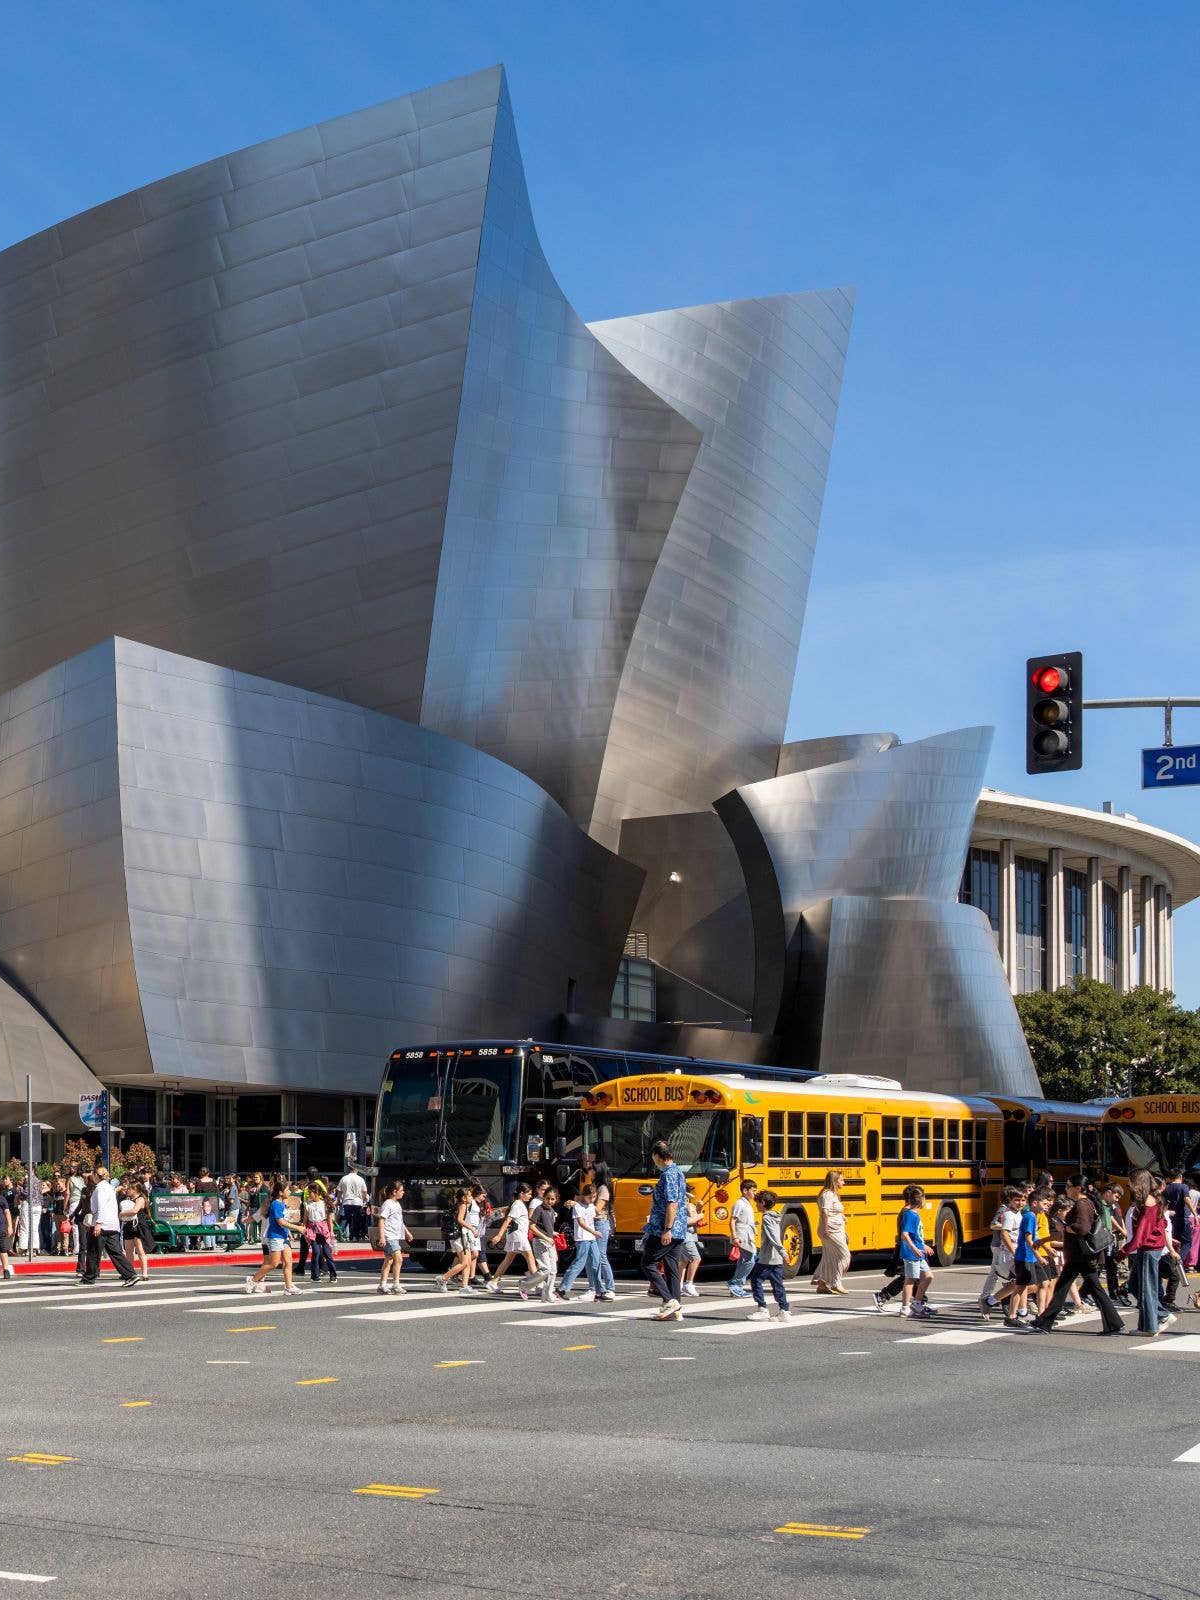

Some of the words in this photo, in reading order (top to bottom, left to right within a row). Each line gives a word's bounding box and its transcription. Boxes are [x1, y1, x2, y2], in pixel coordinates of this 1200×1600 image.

[1156, 753, 1196, 780] 2nd
[624, 1087, 662, 1102] SCHOOL
[664, 1086, 684, 1102] BUS
[1144, 1101, 1178, 1114] SCHOOL
[1181, 1101, 1200, 1114] BUS
